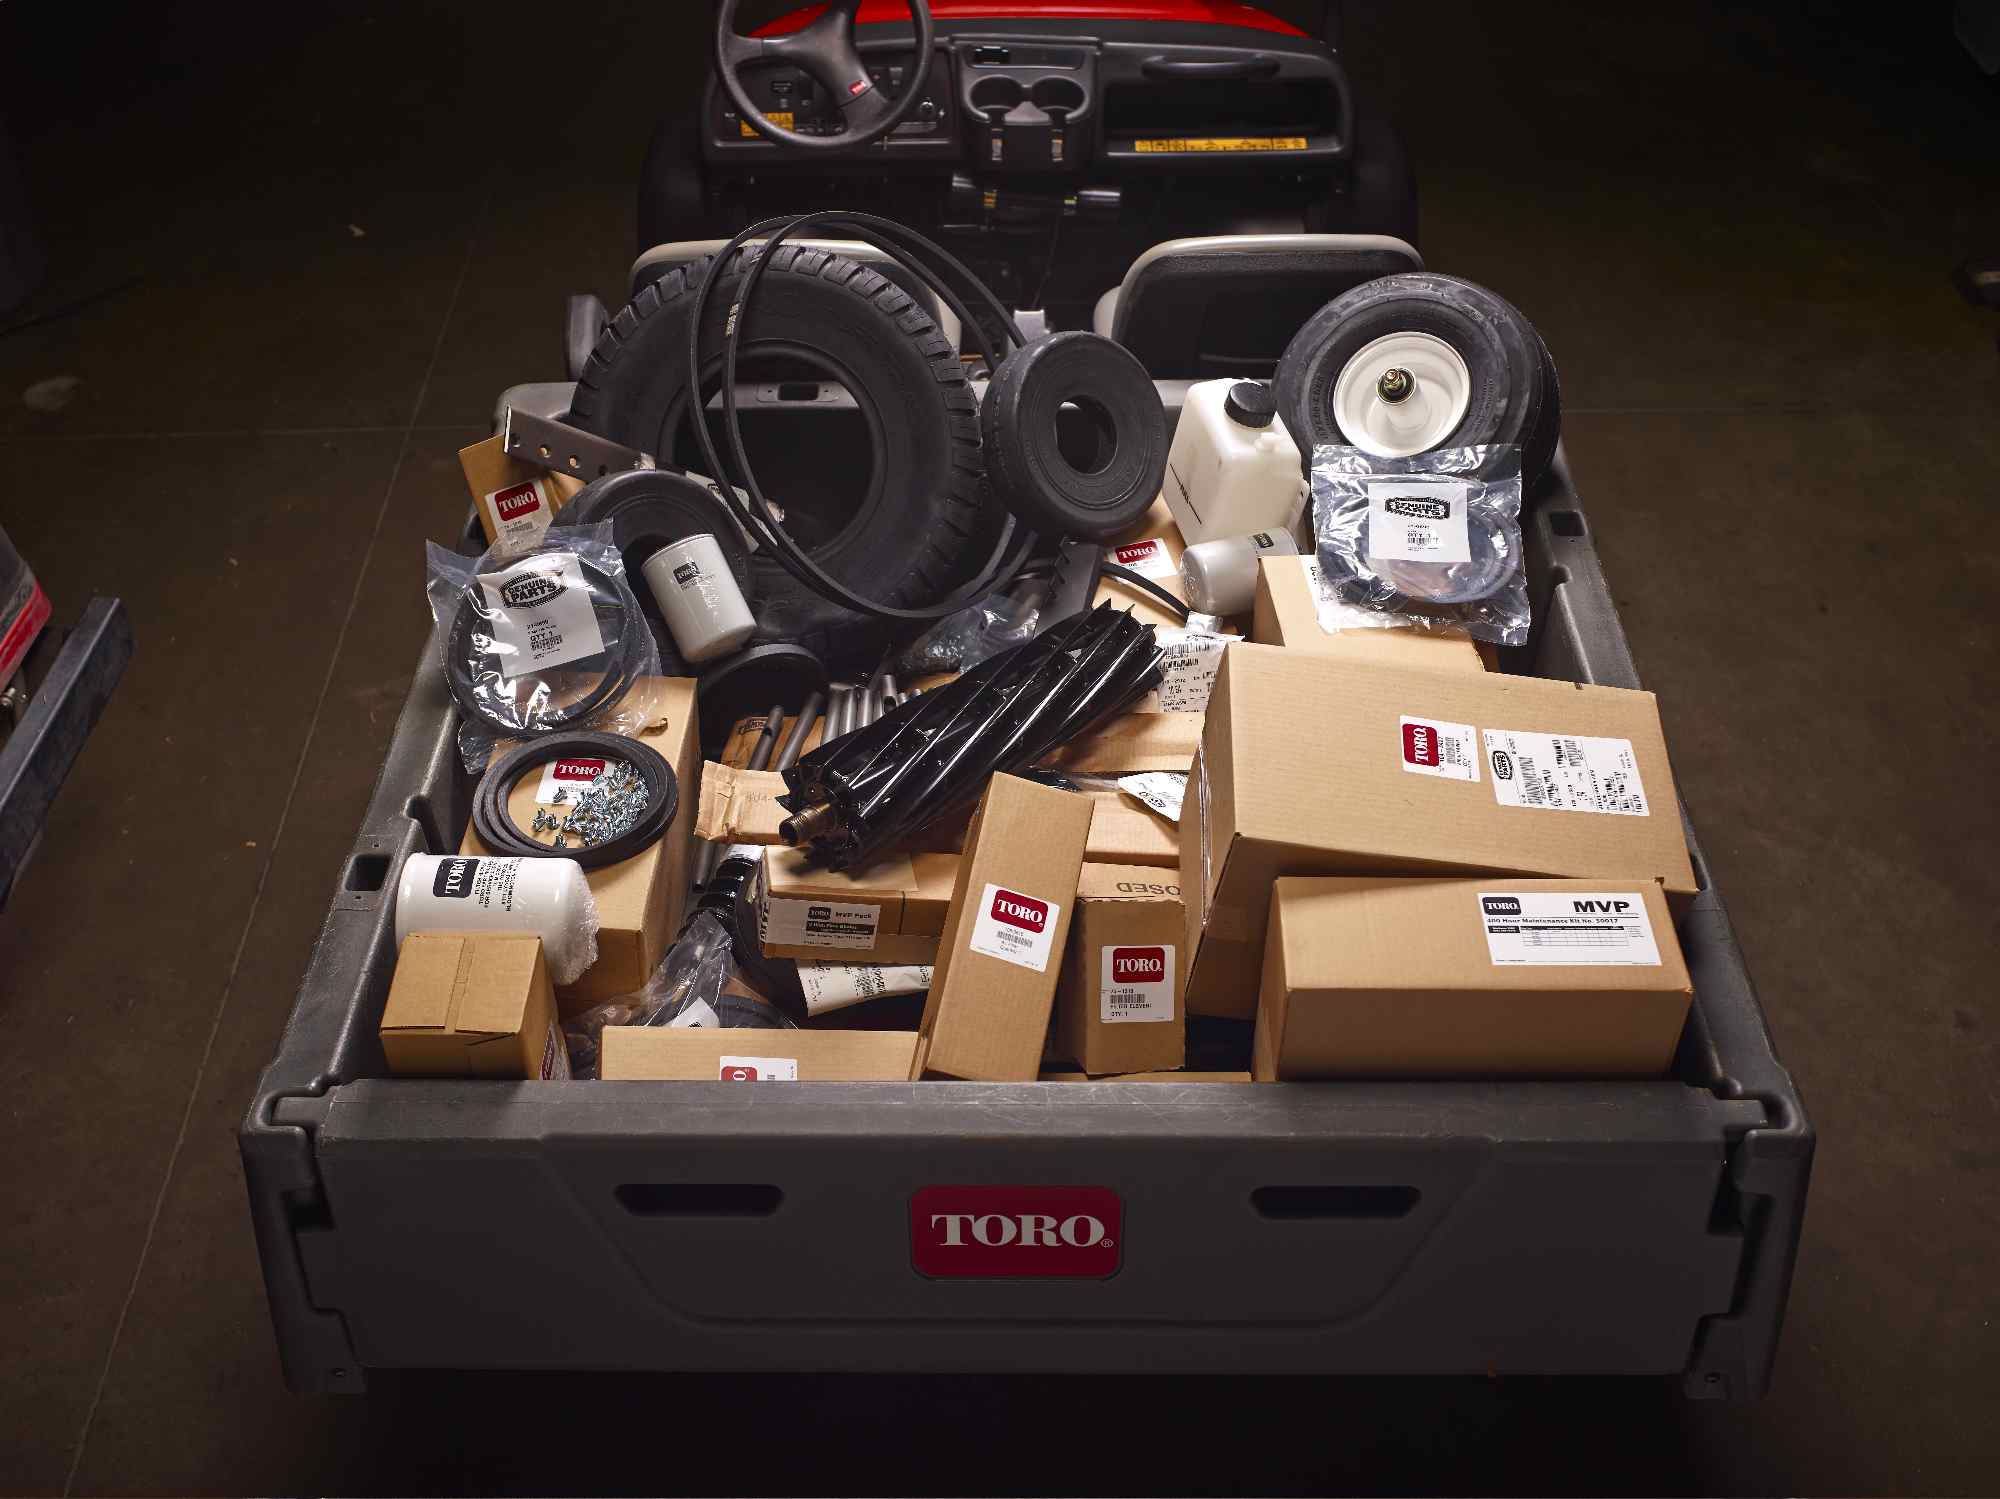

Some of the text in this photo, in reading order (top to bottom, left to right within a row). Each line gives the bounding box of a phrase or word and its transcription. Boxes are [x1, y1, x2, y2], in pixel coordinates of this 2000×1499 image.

[499, 491, 536, 513] TORO
[1119, 546, 1154, 559] TORO
[511, 582, 557, 603] PARTS
[1413, 727, 1429, 762] TORO
[559, 764, 600, 775] TORO
[1501, 753, 1511, 776] PARTS
[445, 859, 468, 895] TORO
[998, 900, 1043, 923] TORO
[1486, 901, 1630, 912] TORO MVP
[1117, 958, 1162, 973] TORO
[931, 1214, 1105, 1247] TORO
